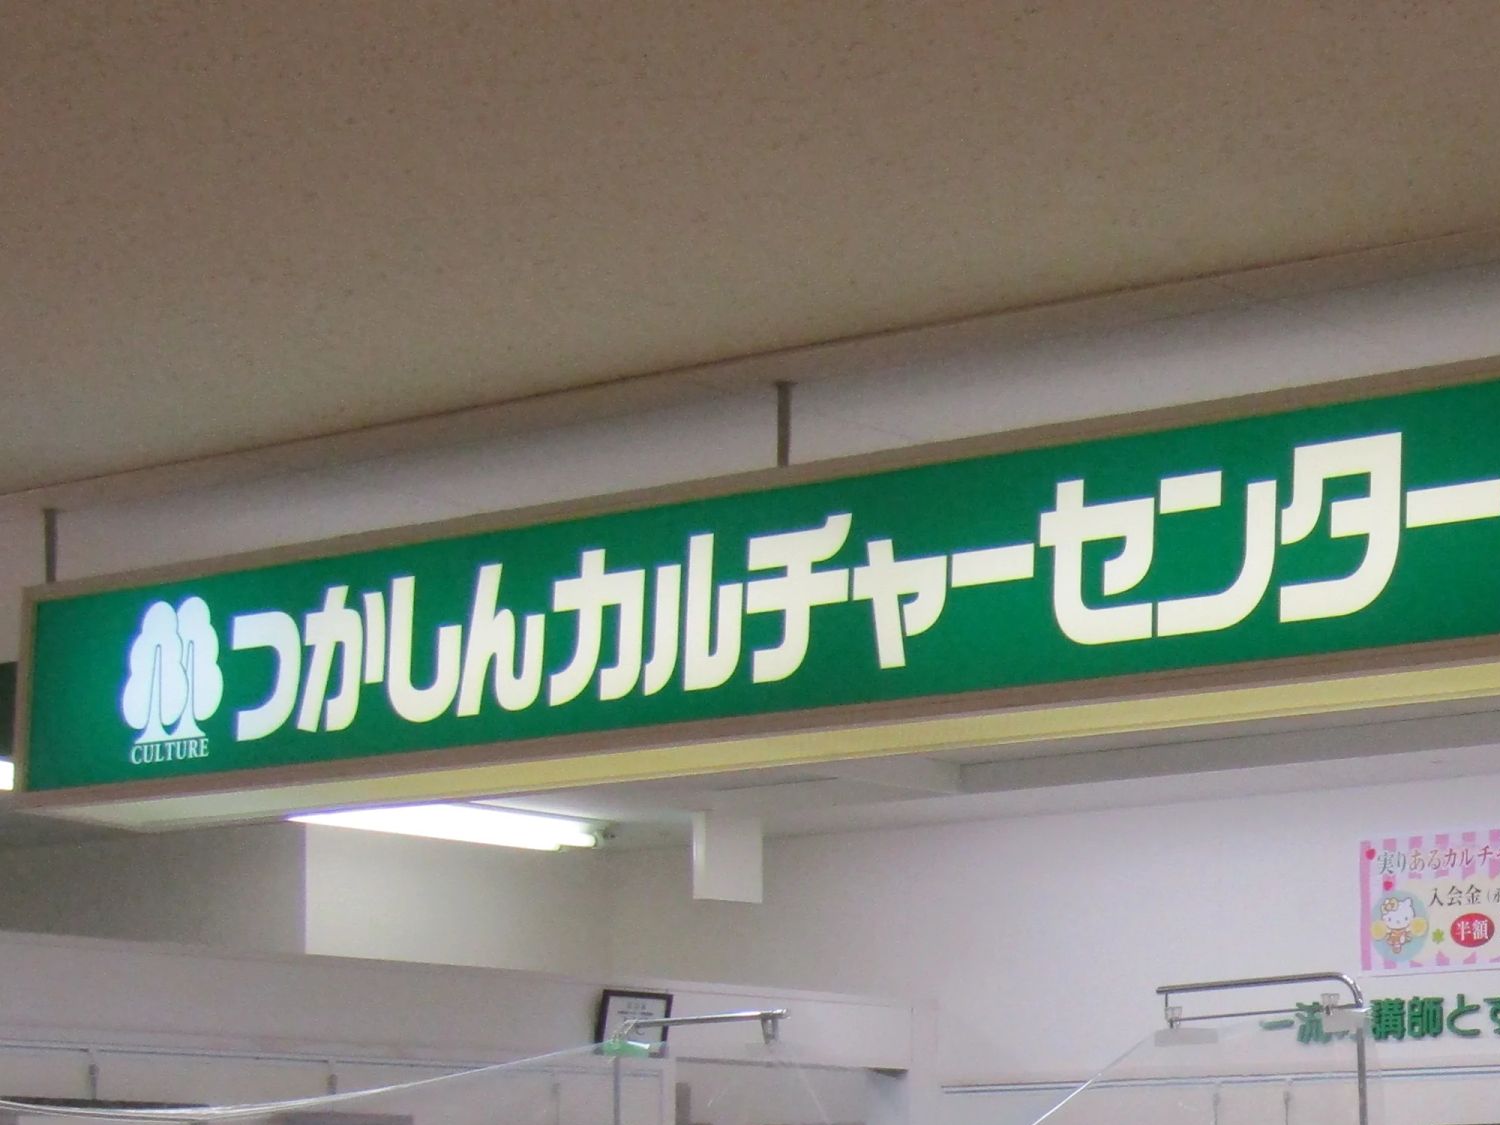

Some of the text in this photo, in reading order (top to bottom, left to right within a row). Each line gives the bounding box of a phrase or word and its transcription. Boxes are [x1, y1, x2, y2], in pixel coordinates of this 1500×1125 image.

[131, 737, 209, 765] CULTURE
[1428, 883, 1482, 907] 入会金
[1455, 918, 1489, 941] 半額
